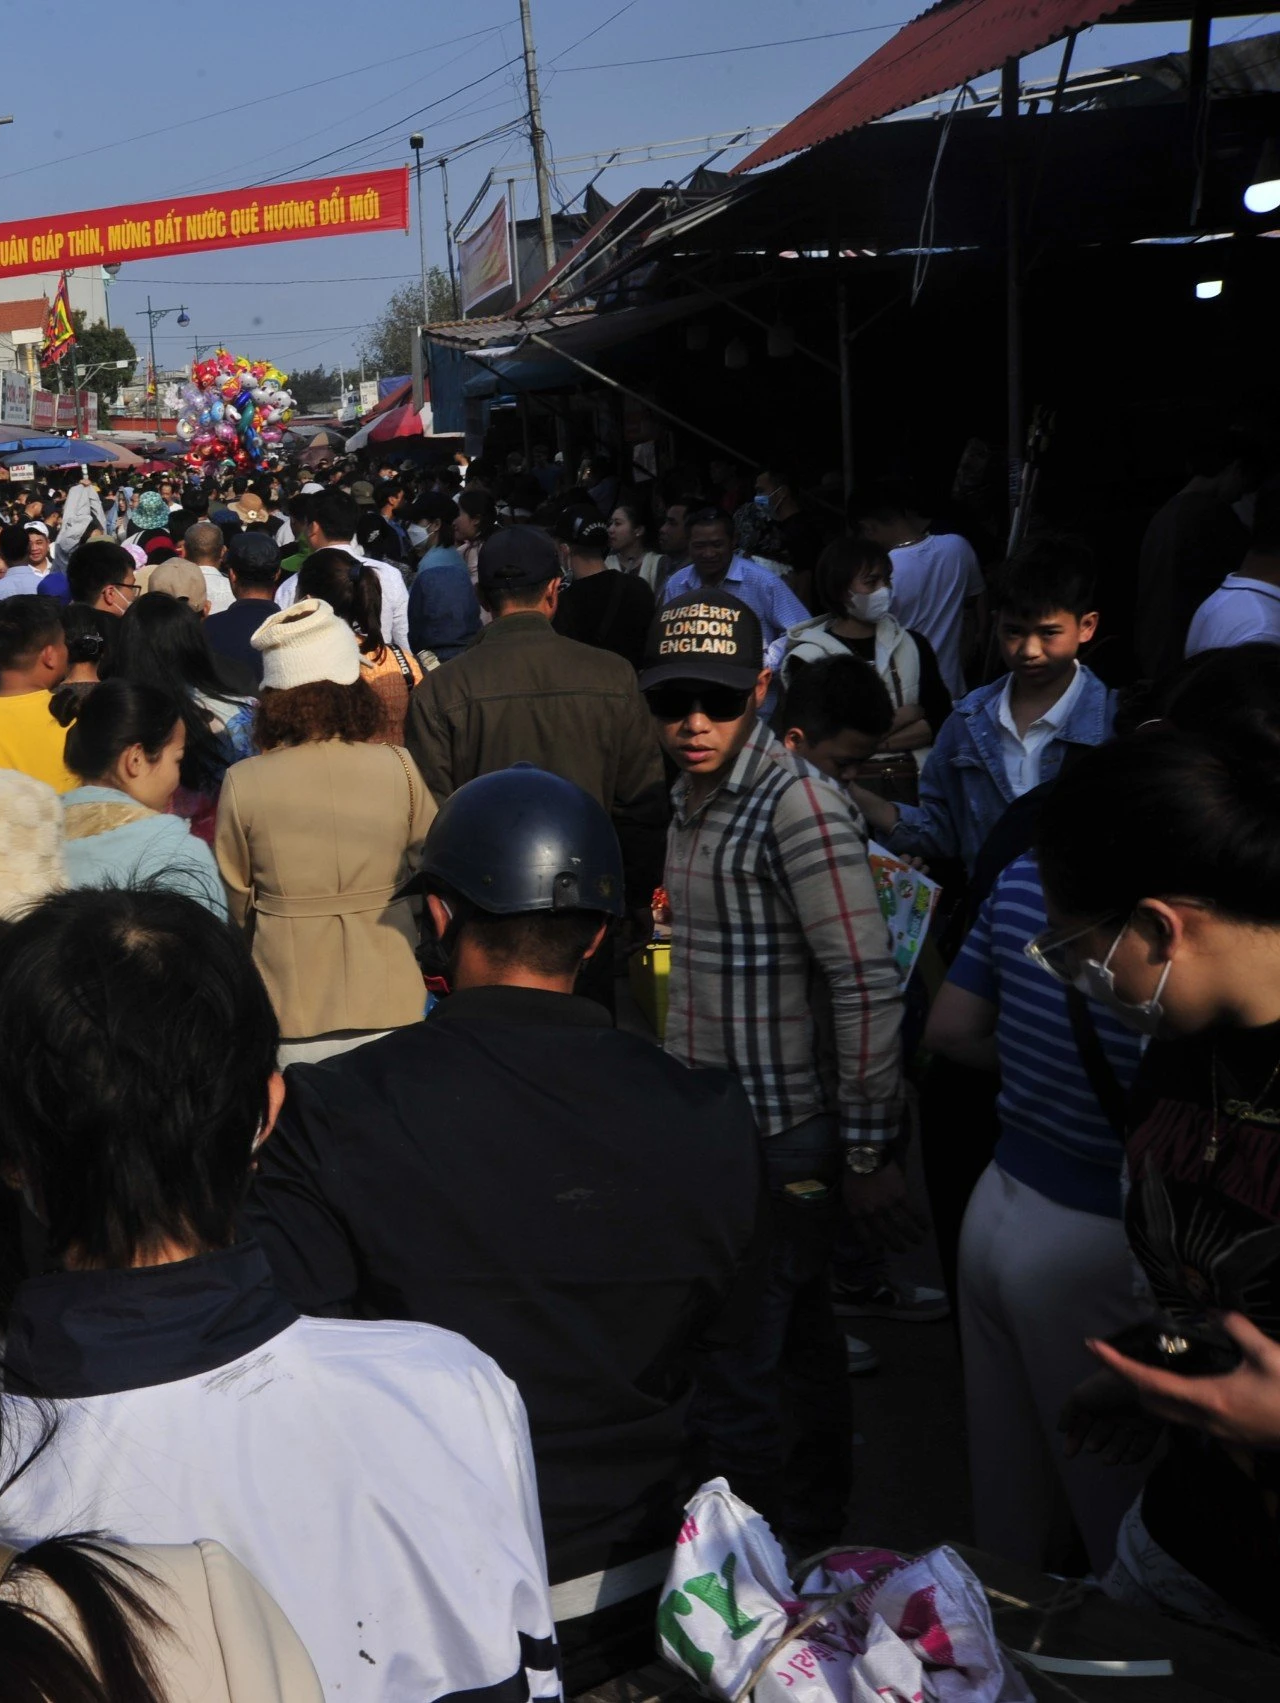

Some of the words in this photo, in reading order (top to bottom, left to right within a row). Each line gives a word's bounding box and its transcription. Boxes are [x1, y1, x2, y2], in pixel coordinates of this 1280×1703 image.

[32, 229, 64, 263] GIÁP
[68, 224, 104, 257] THÌN,
[108, 218, 151, 252] MỪNG
[154, 208, 182, 246] ĐẤT
[186, 207, 227, 242] NƯỚC
[231, 201, 259, 239] QUÊ
[263, 199, 316, 232] HƯƠNG
[319, 186, 346, 226] ĐỔI
[349, 187, 380, 222] MỚI
[661, 603, 741, 622] BURBERRY
[665, 620, 733, 637] LONDON
[660, 638, 737, 655] ENGLAND
